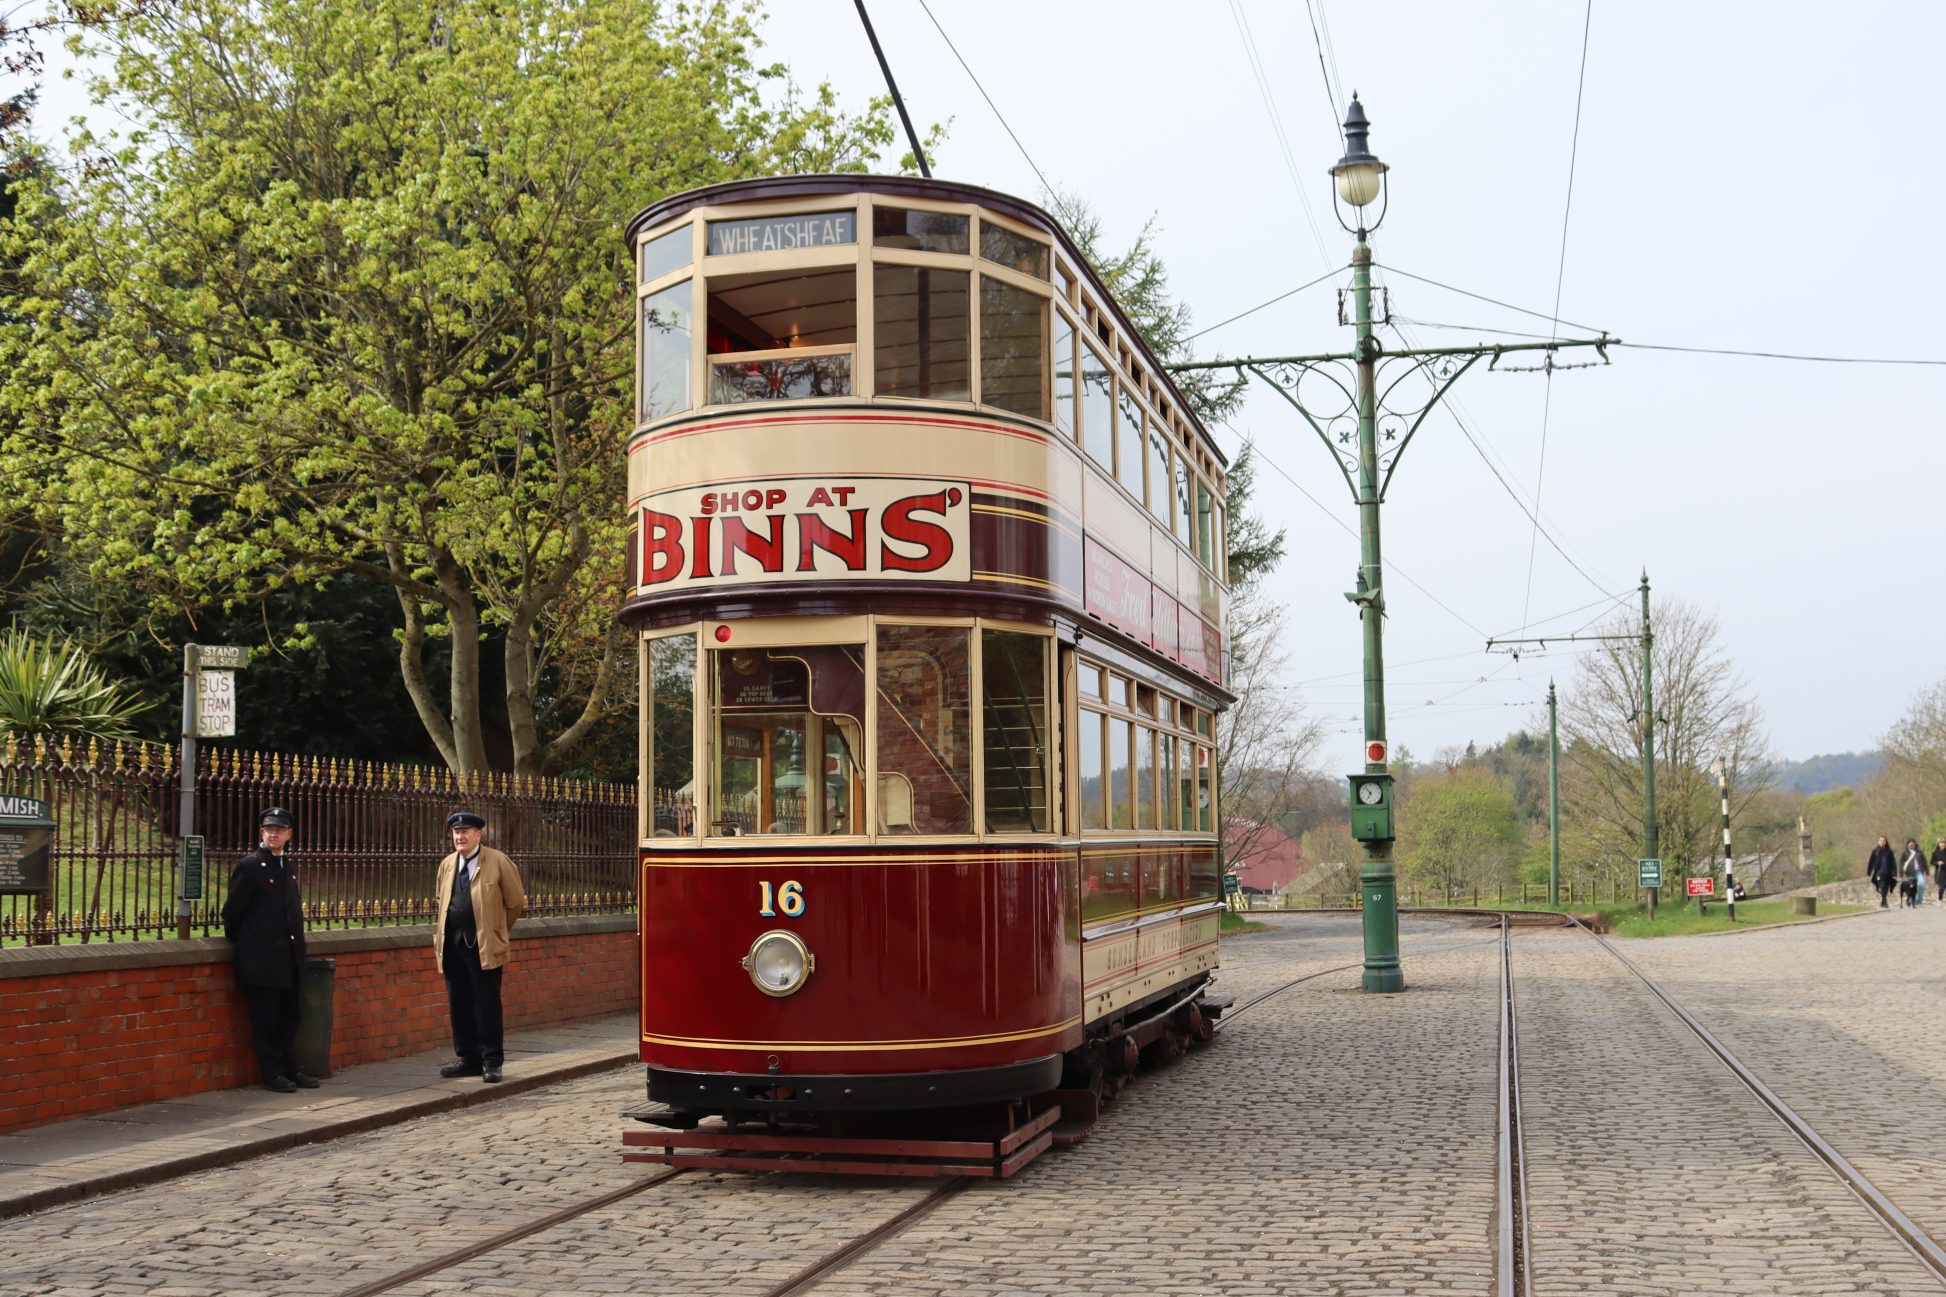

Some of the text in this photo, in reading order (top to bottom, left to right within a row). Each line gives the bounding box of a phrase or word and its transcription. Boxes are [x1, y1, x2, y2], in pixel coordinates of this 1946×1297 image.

[700, 486, 856, 515] SHOP AT
[641, 487, 963, 588] BINNS'
[204, 646, 240, 658] STAND
[200, 656, 239, 666] THIS SIDE
[199, 677, 230, 693] BUS
[200, 697, 231, 713] TRAM
[199, 715, 231, 731] STOP
[759, 880, 806, 917] 16
